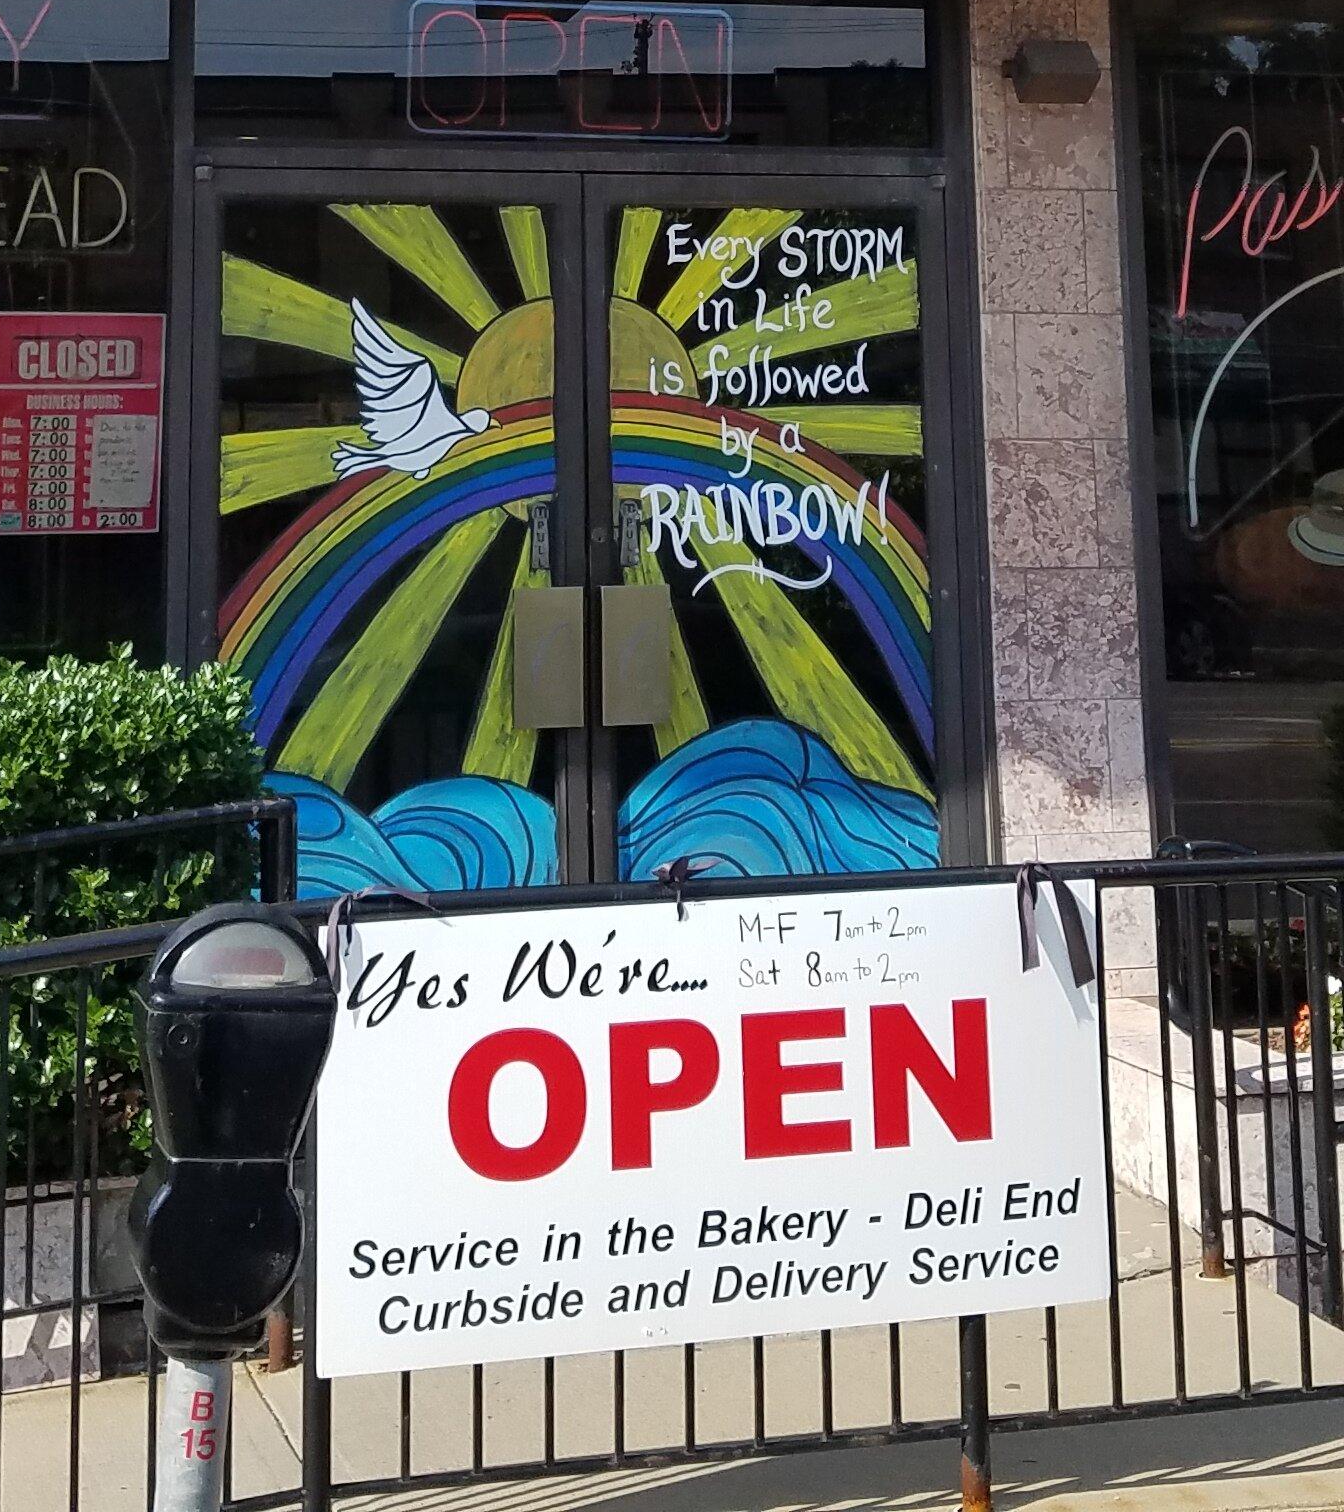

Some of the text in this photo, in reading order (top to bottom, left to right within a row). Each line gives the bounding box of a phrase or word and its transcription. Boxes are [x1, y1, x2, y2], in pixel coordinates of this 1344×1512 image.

[420, 10, 725, 133] OPEN
[666, 222, 909, 289] Every STORM
[697, 282, 836, 334] in Life
[17, 339, 136, 380] CLOSED
[649, 342, 870, 407] is followed
[31, 416, 70, 430] 7:00
[31, 432, 68, 446] 7:00
[30, 448, 67, 462] 7:00
[720, 415, 806, 479] by a
[29, 481, 67, 495] 7:00
[30, 465, 67, 478] 7:00
[27, 513, 66, 528] 8:00
[99, 512, 138, 528] 2:00
[28, 497, 67, 510] 8:00
[738, 910, 798, 944] M-F
[868, 915, 883, 934] to
[887, 906, 928, 941] 2pm
[346, 949, 469, 1029] Yes
[738, 957, 782, 989] Sat
[853, 956, 872, 981] to
[876, 952, 921, 990] 2pm
[448, 997, 994, 1182] OPEN
[348, 1176, 1082, 1280] Service in the Bakery - Deli End
[378, 1239, 1060, 1335] Curbside and Delivery Service
[190, 1390, 215, 1422] B
[180, 1428, 217, 1460] 15
